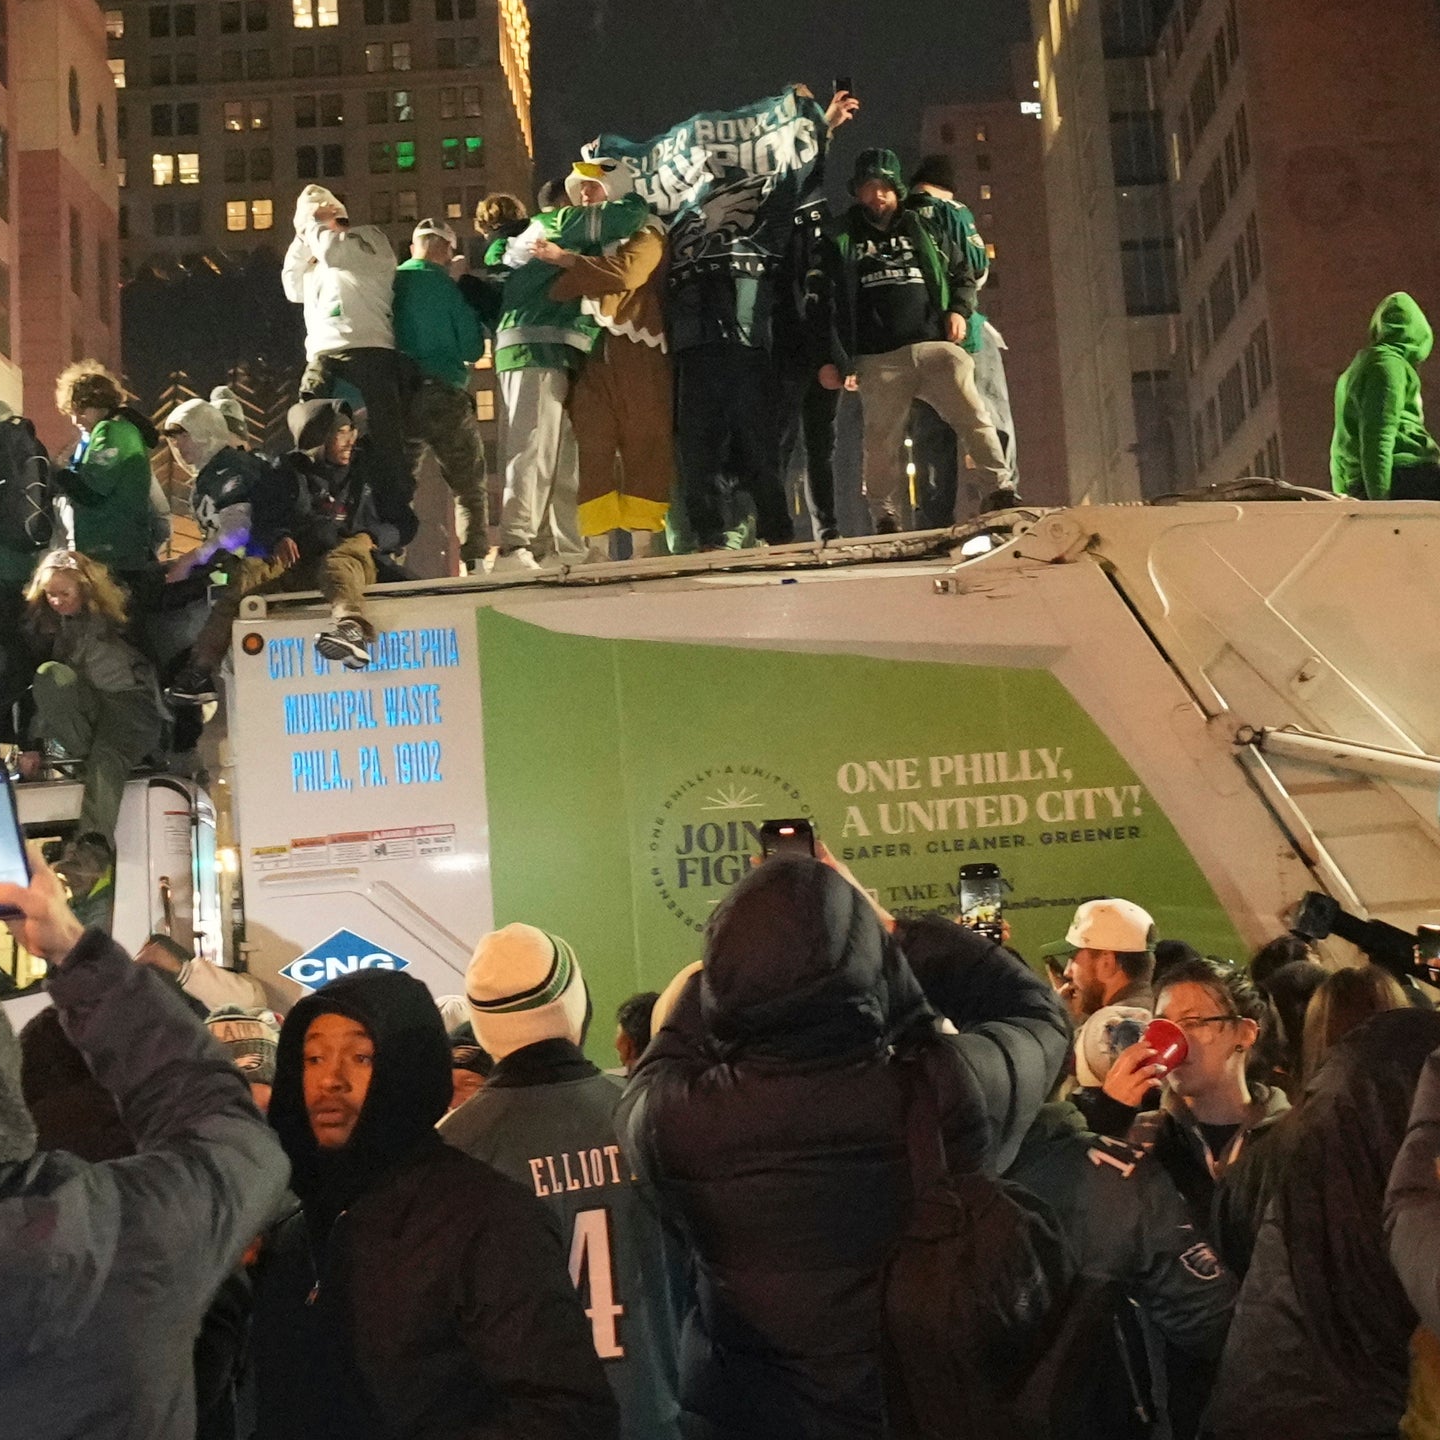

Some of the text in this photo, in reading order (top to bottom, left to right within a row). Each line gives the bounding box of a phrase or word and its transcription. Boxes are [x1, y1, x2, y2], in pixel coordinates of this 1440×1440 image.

[622, 127, 689, 179] SUPER
[267, 637, 305, 680] CITY
[284, 683, 442, 735] MUNICIPAL WASTE
[292, 740, 443, 793] PHILA., PA. 19102
[837, 746, 1074, 795] ONE PHILLY,
[841, 785, 1143, 838] A UNITED CITY!
[675, 820, 763, 855] JOIN
[676, 854, 752, 889] FIG
[887, 882, 938, 903] TAKE
[290, 952, 395, 983] CNG
[528, 1144, 638, 1198] ELLIOT
[567, 1208, 624, 1358] 4
